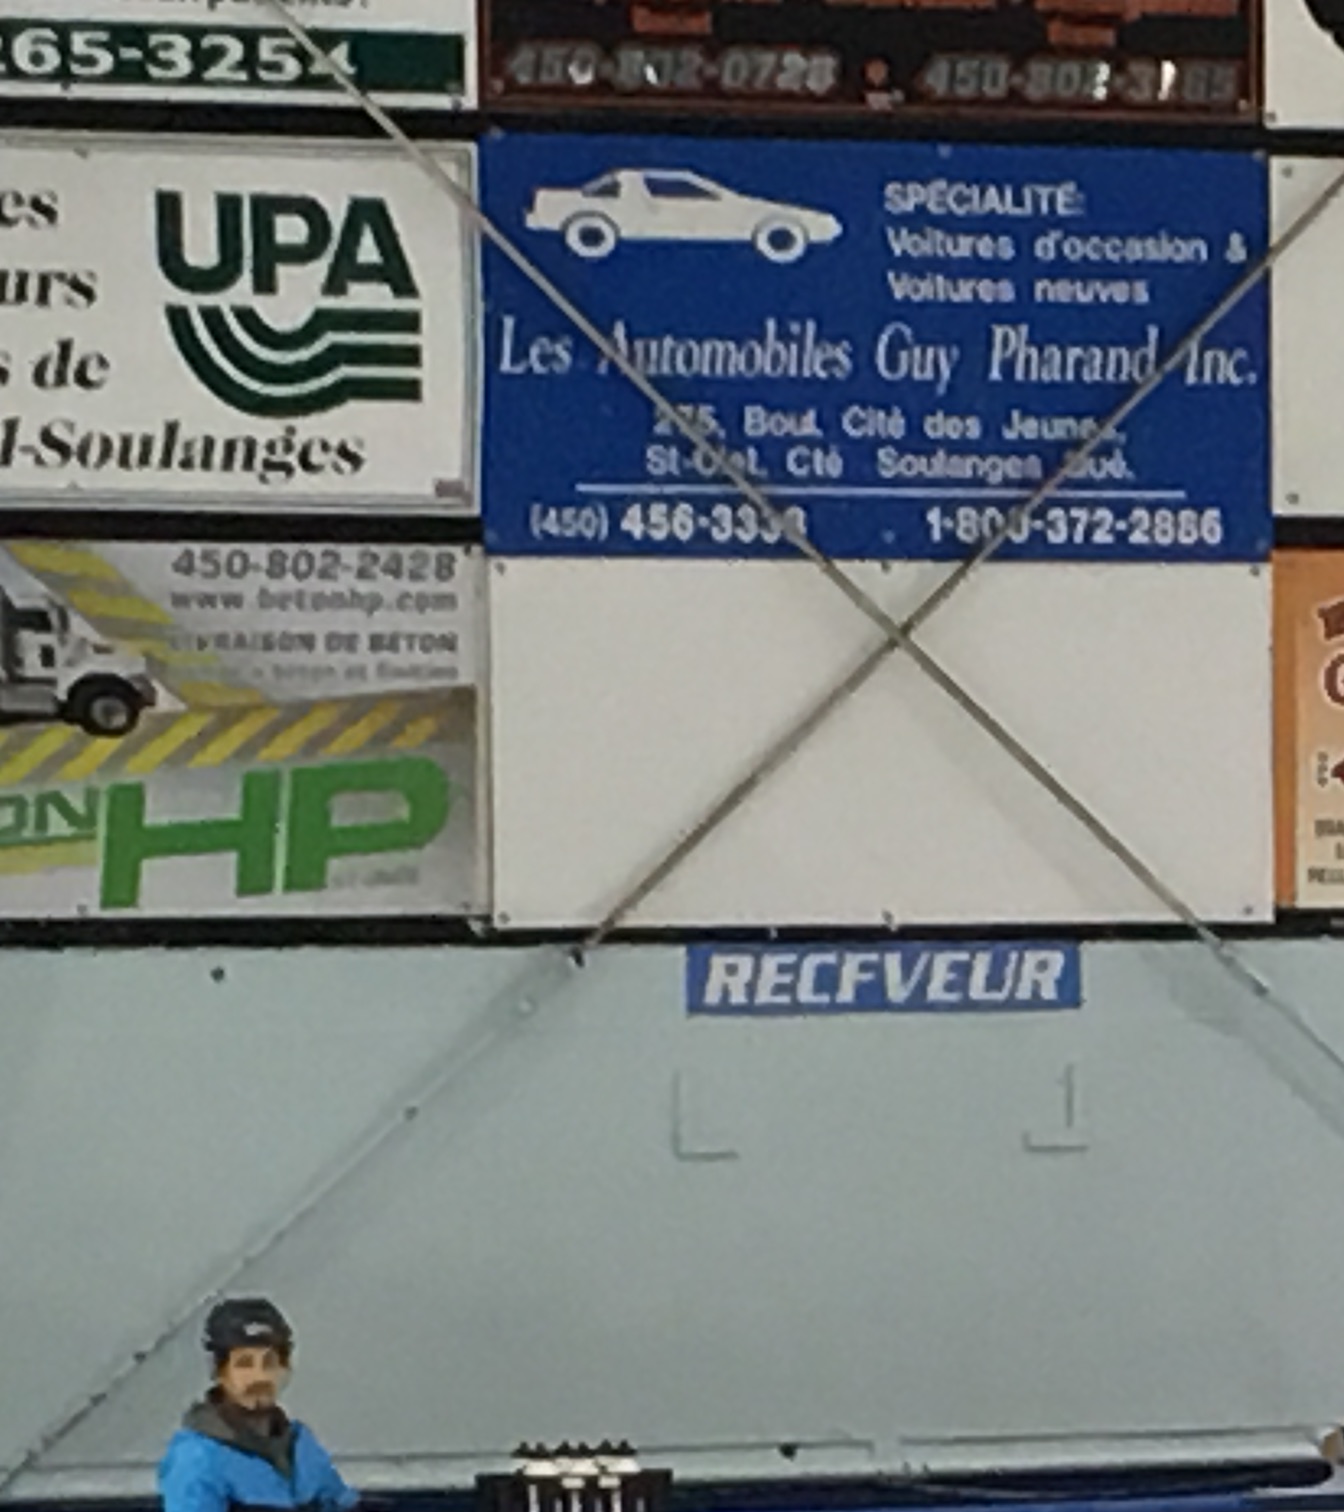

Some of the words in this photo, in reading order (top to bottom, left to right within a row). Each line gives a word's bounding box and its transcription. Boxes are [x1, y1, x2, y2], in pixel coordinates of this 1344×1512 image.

[0, 27, 357, 82] 65-3254
[154, 189, 420, 299] UPA
[885, 225, 1016, 260] Voitures
[1033, 230, 1209, 263] d'occasion
[1225, 231, 1248, 264] &
[886, 270, 1016, 303] Voitures
[1033, 277, 1150, 304] neuves
[31, 338, 110, 390] de
[499, 314, 573, 375] Les
[596, 316, 853, 381] Automobiles
[874, 321, 960, 397] Guy
[988, 322, 1160, 384] Pharand
[1183, 338, 1259, 386] Inc.
[922, 409, 982, 439] des
[876, 446, 1043, 484] Soulanges
[529, 503, 610, 541] (450)
[171, 549, 457, 582] 450-802-2428
[100, 756, 450, 910] HP
